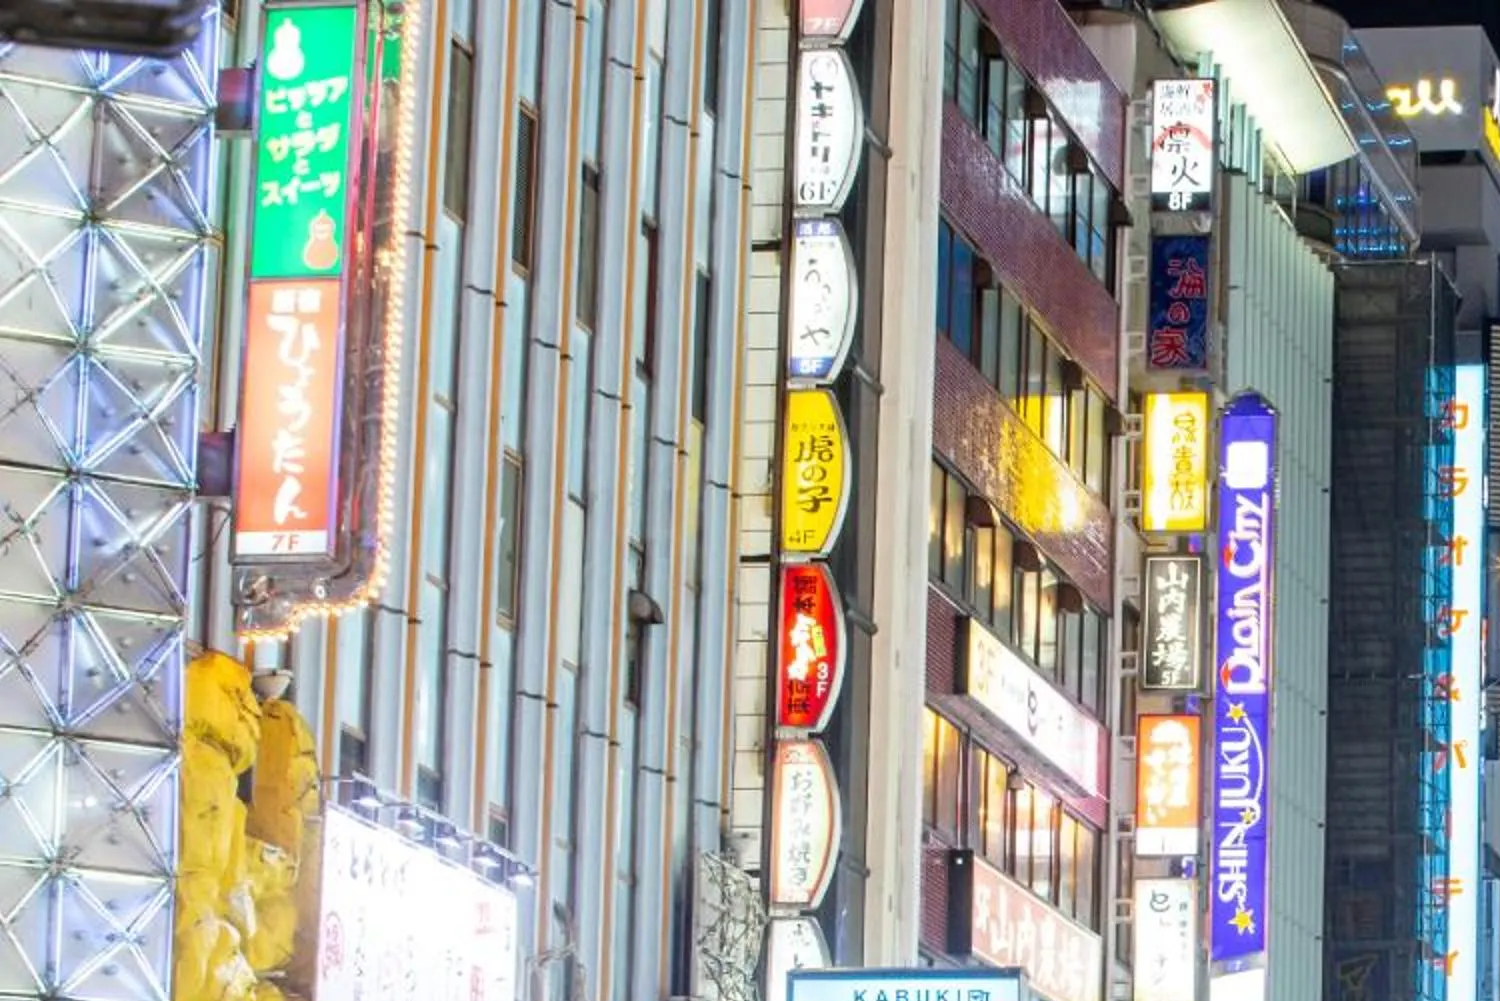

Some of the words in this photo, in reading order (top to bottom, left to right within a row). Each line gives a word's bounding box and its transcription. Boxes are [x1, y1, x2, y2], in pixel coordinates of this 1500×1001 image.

[261, 174, 340, 207] スイーツ
[266, 314, 320, 524] ひょうたん
[794, 434, 835, 513] 虎の子
[272, 534, 300, 551] 7F
[816, 663, 829, 698] 3F
